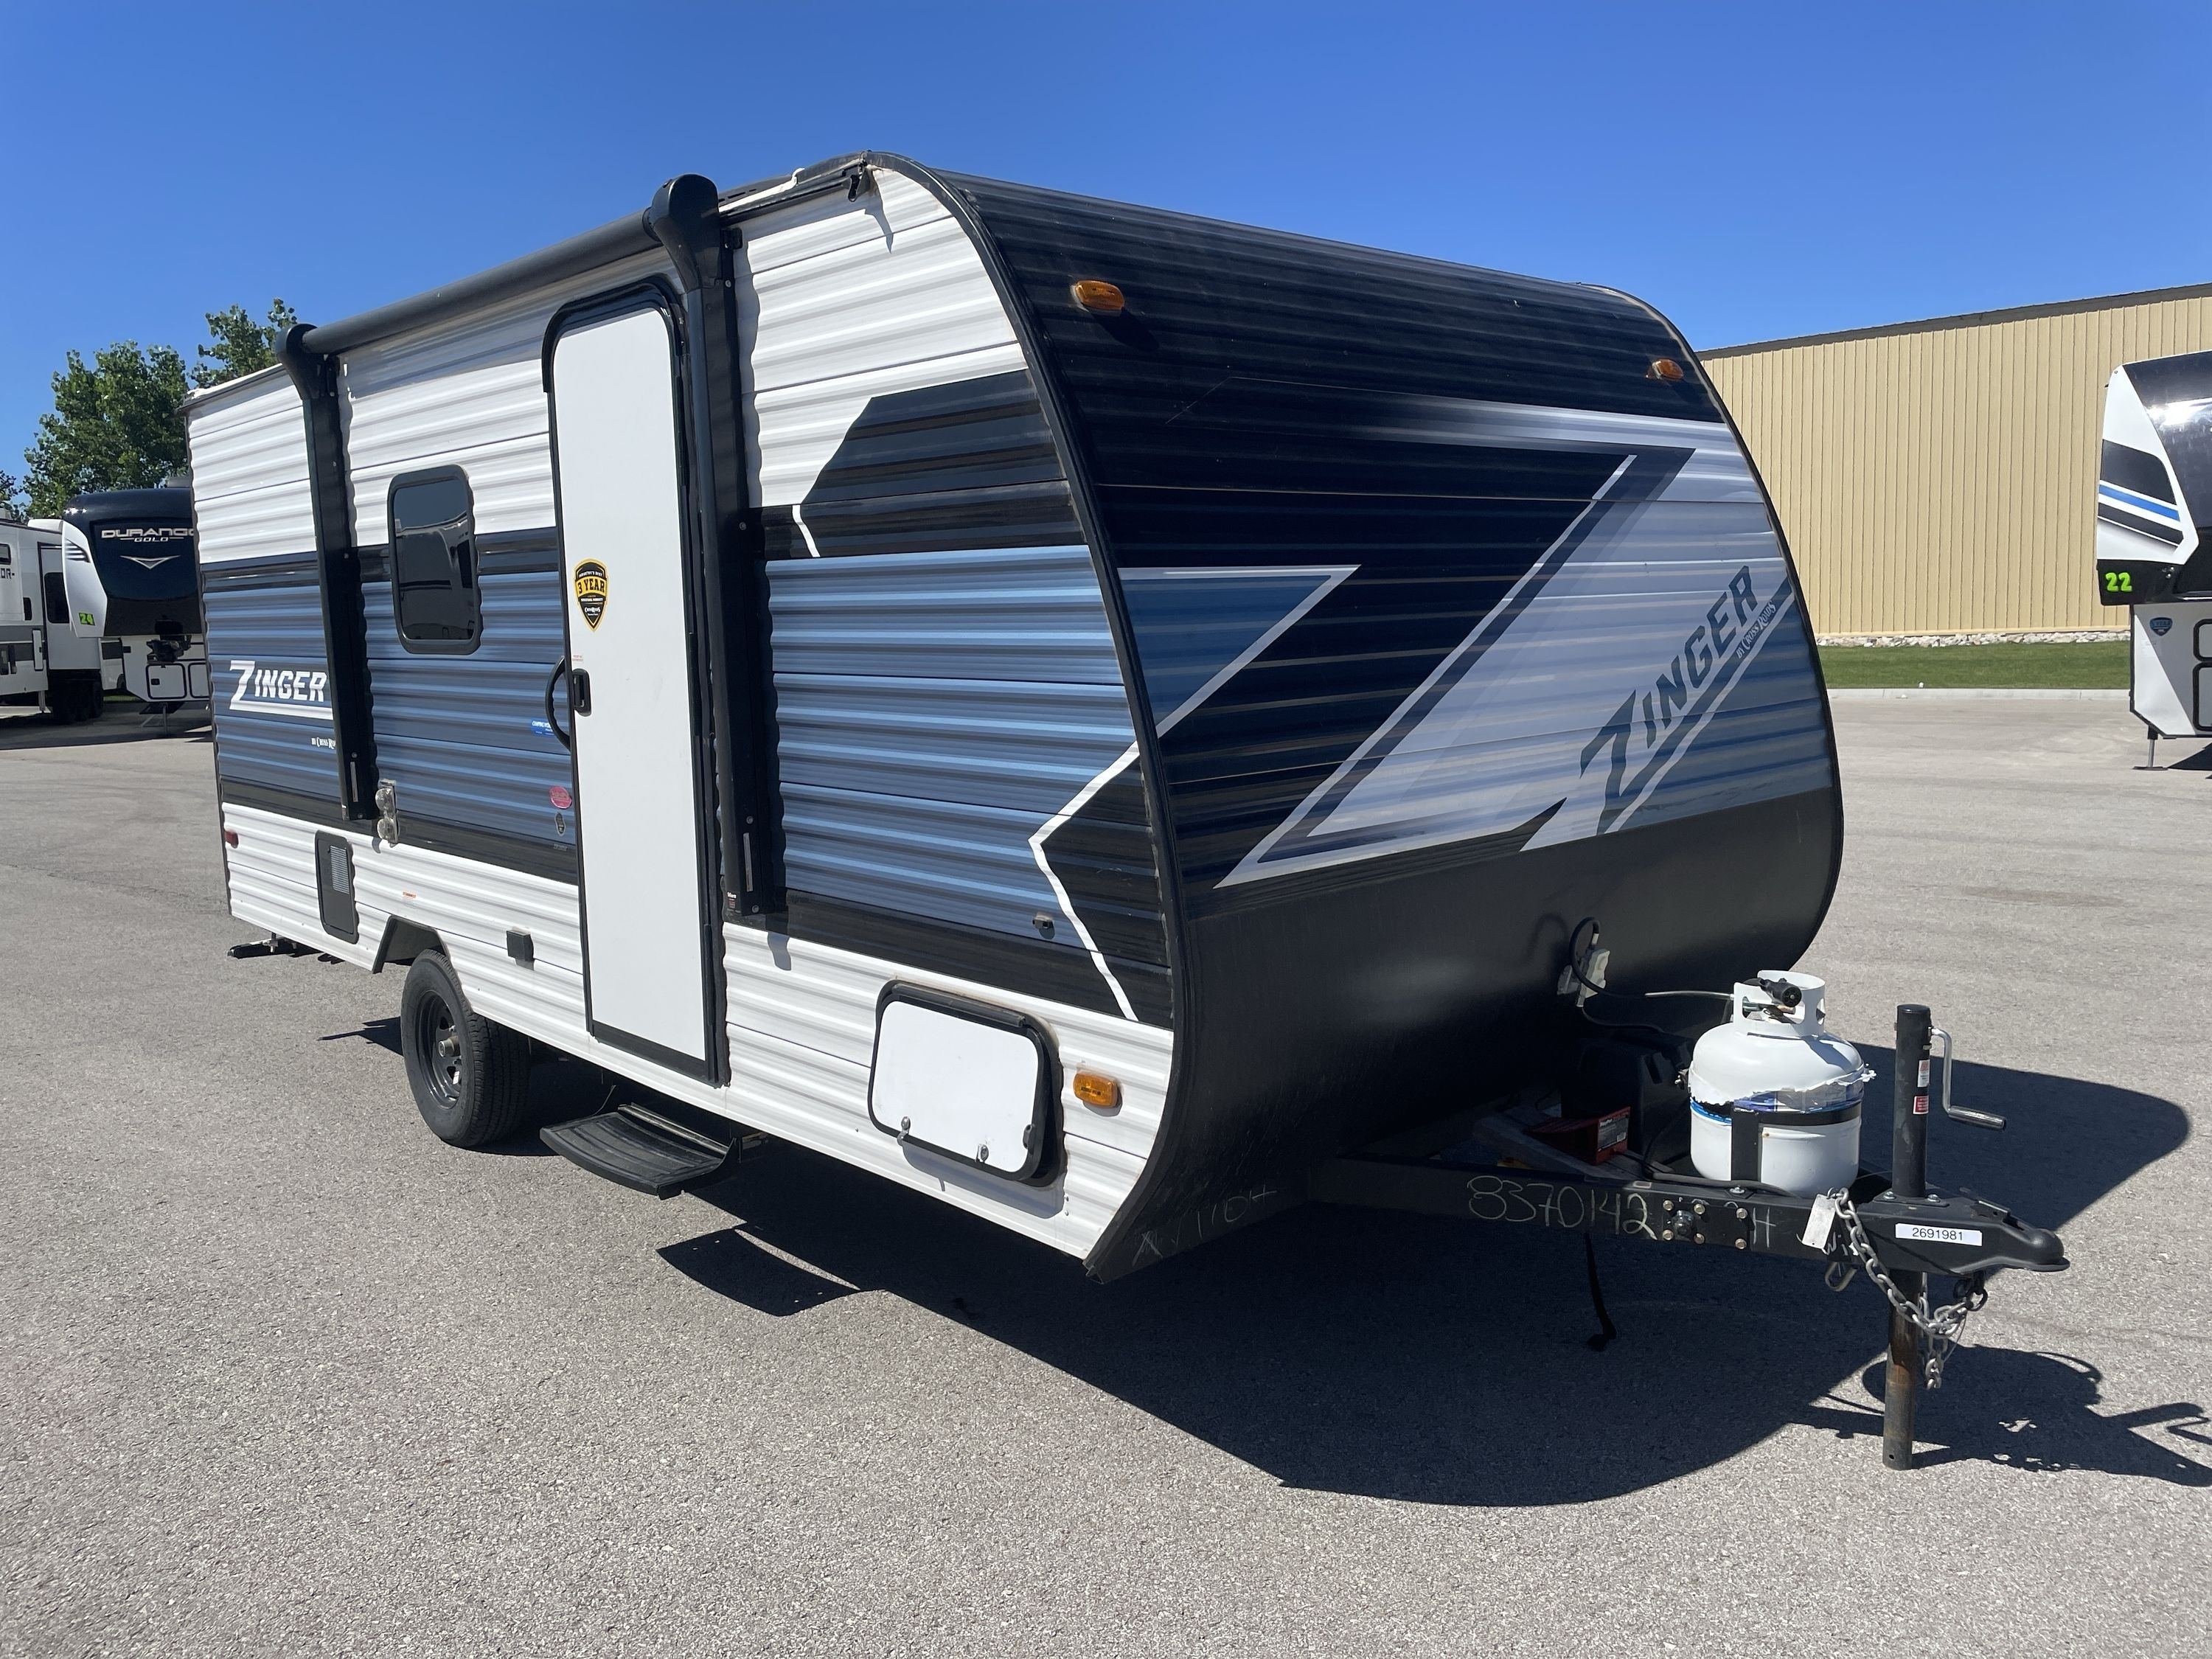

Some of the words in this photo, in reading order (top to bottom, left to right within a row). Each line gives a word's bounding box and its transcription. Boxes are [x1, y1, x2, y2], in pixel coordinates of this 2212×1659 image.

[577, 582, 582, 594] 3
[584, 578, 605, 593] YEAR
[2105, 572, 2132, 591] 22
[229, 660, 333, 720] ZINGER
[1579, 566, 1759, 835] ZINGER
[1467, 1175, 1658, 1241] 8370142
[1912, 1227, 1963, 1241] 2691981
